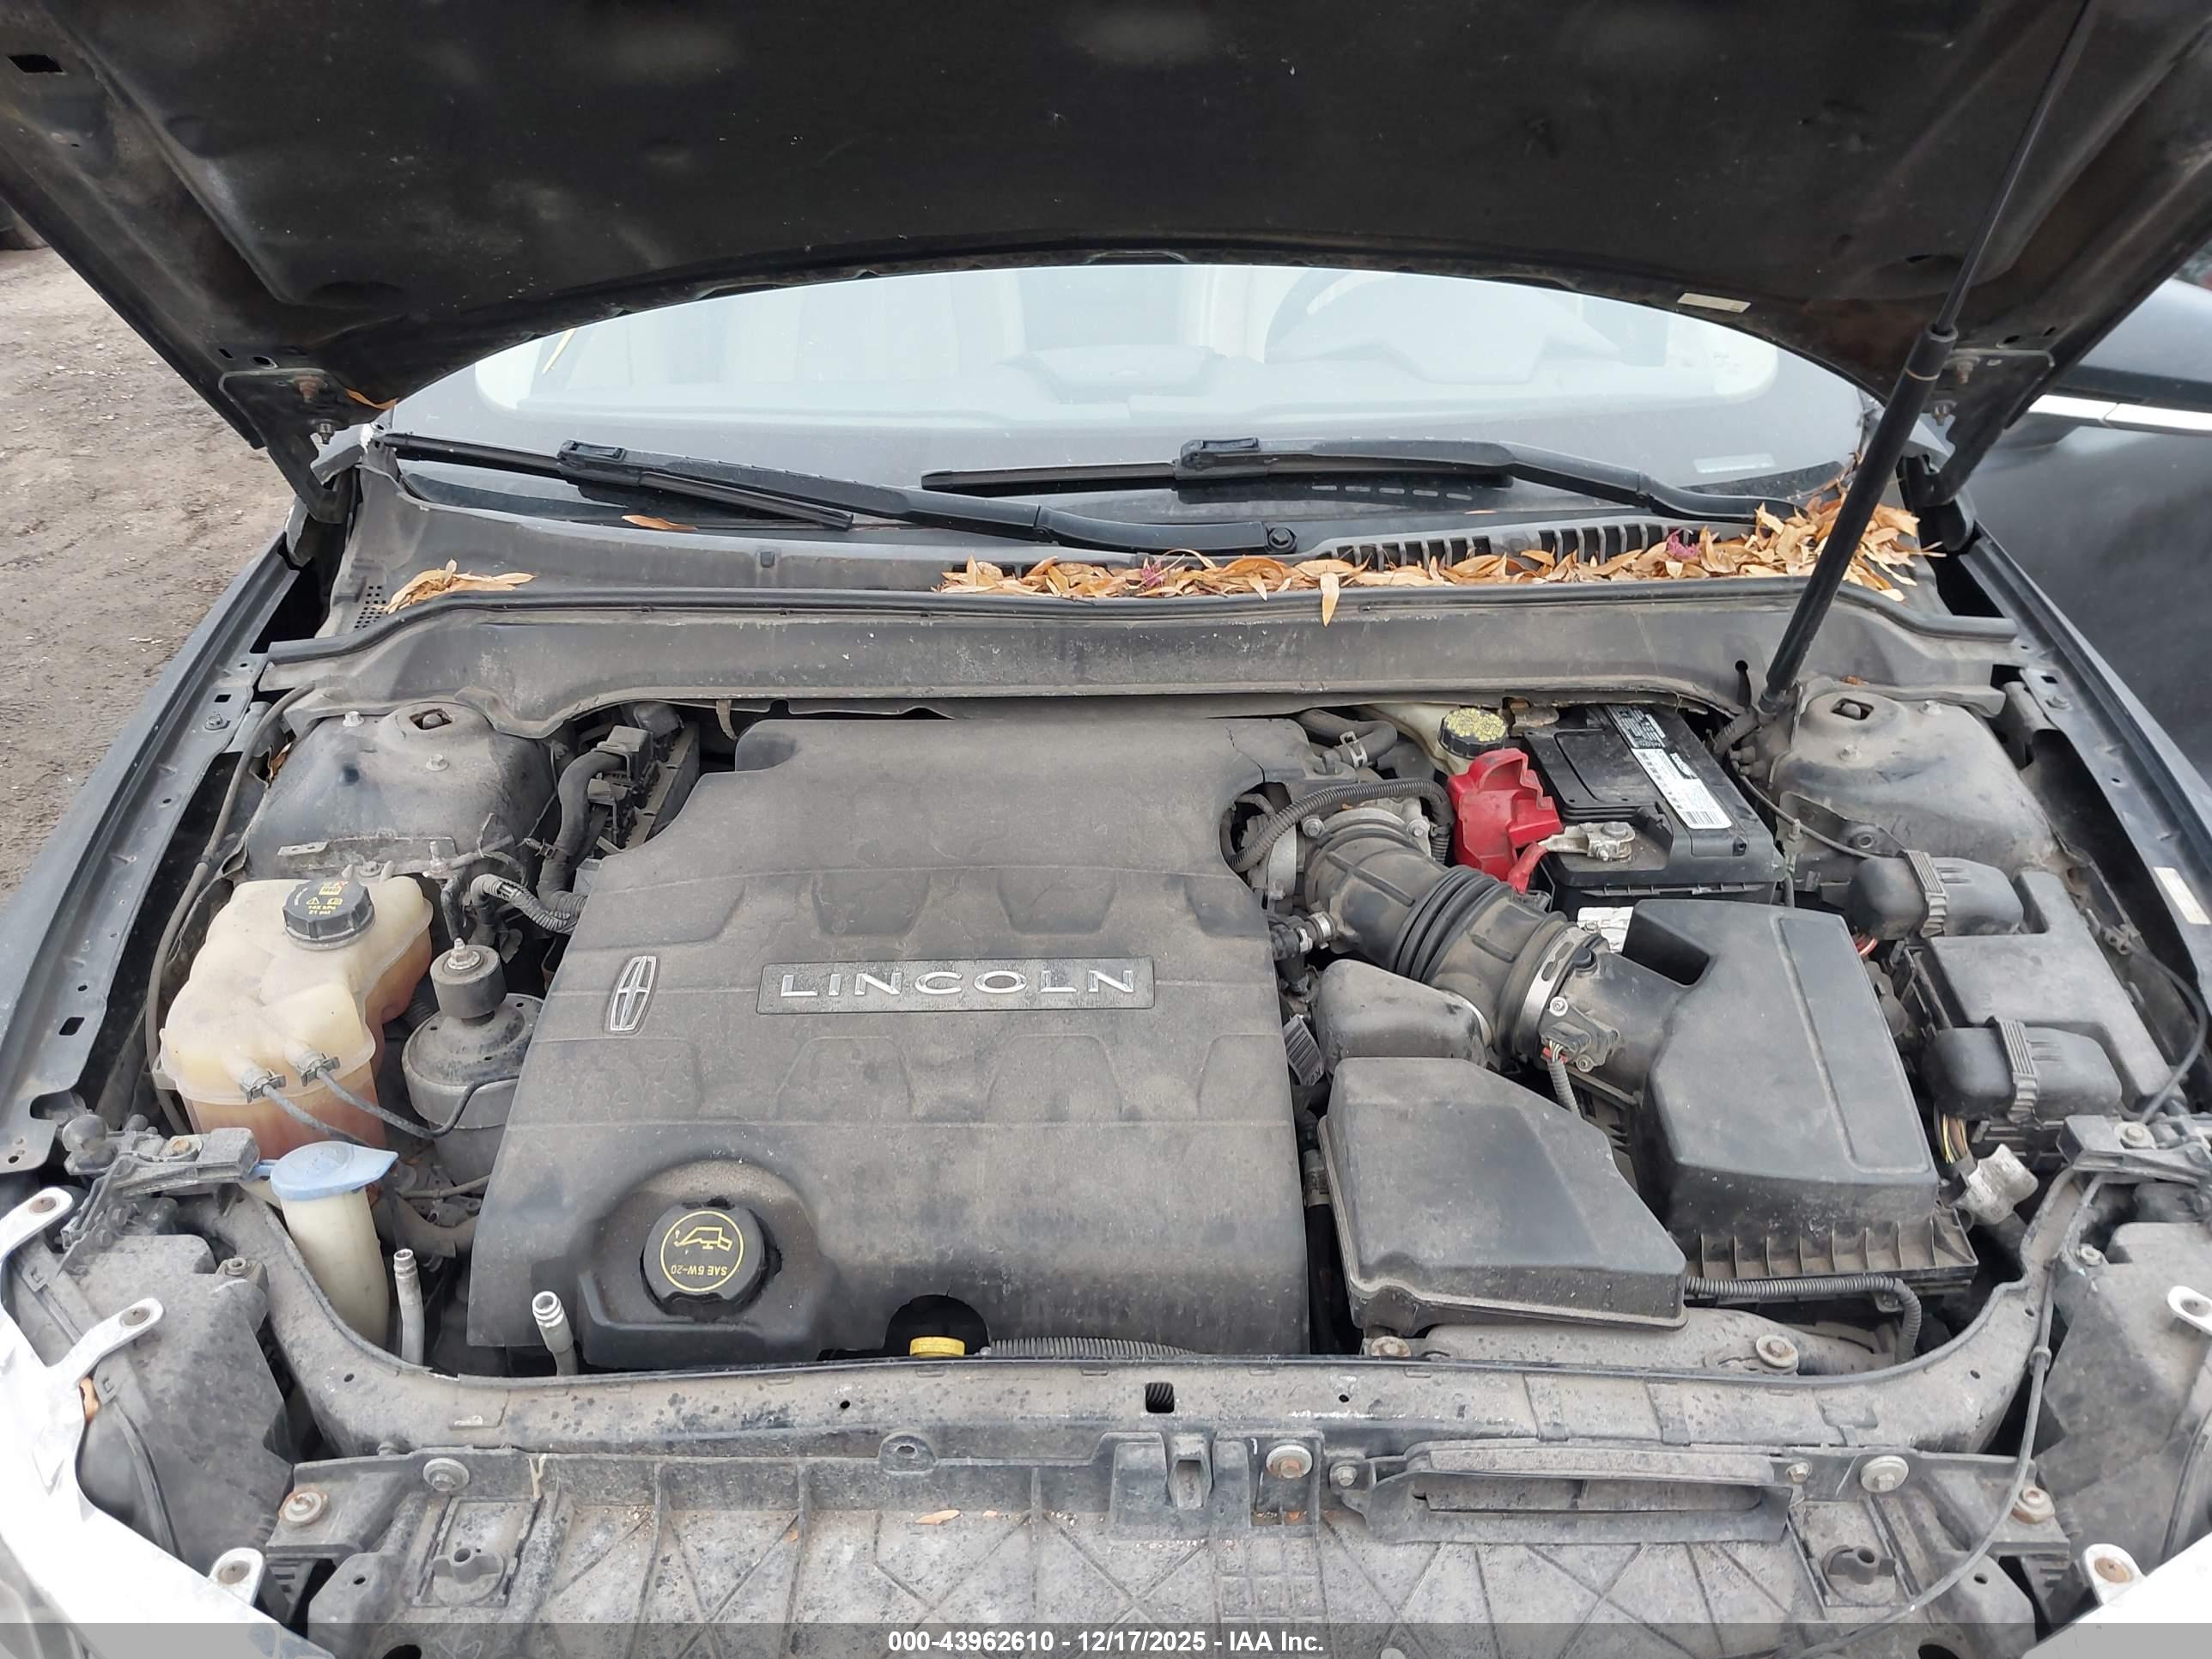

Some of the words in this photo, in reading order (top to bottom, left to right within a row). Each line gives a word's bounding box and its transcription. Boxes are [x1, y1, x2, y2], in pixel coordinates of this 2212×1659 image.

[780, 969, 1135, 998] LINCOLN
[671, 1264, 705, 1276] 5W-20
[707, 1265, 728, 1276] SAE
